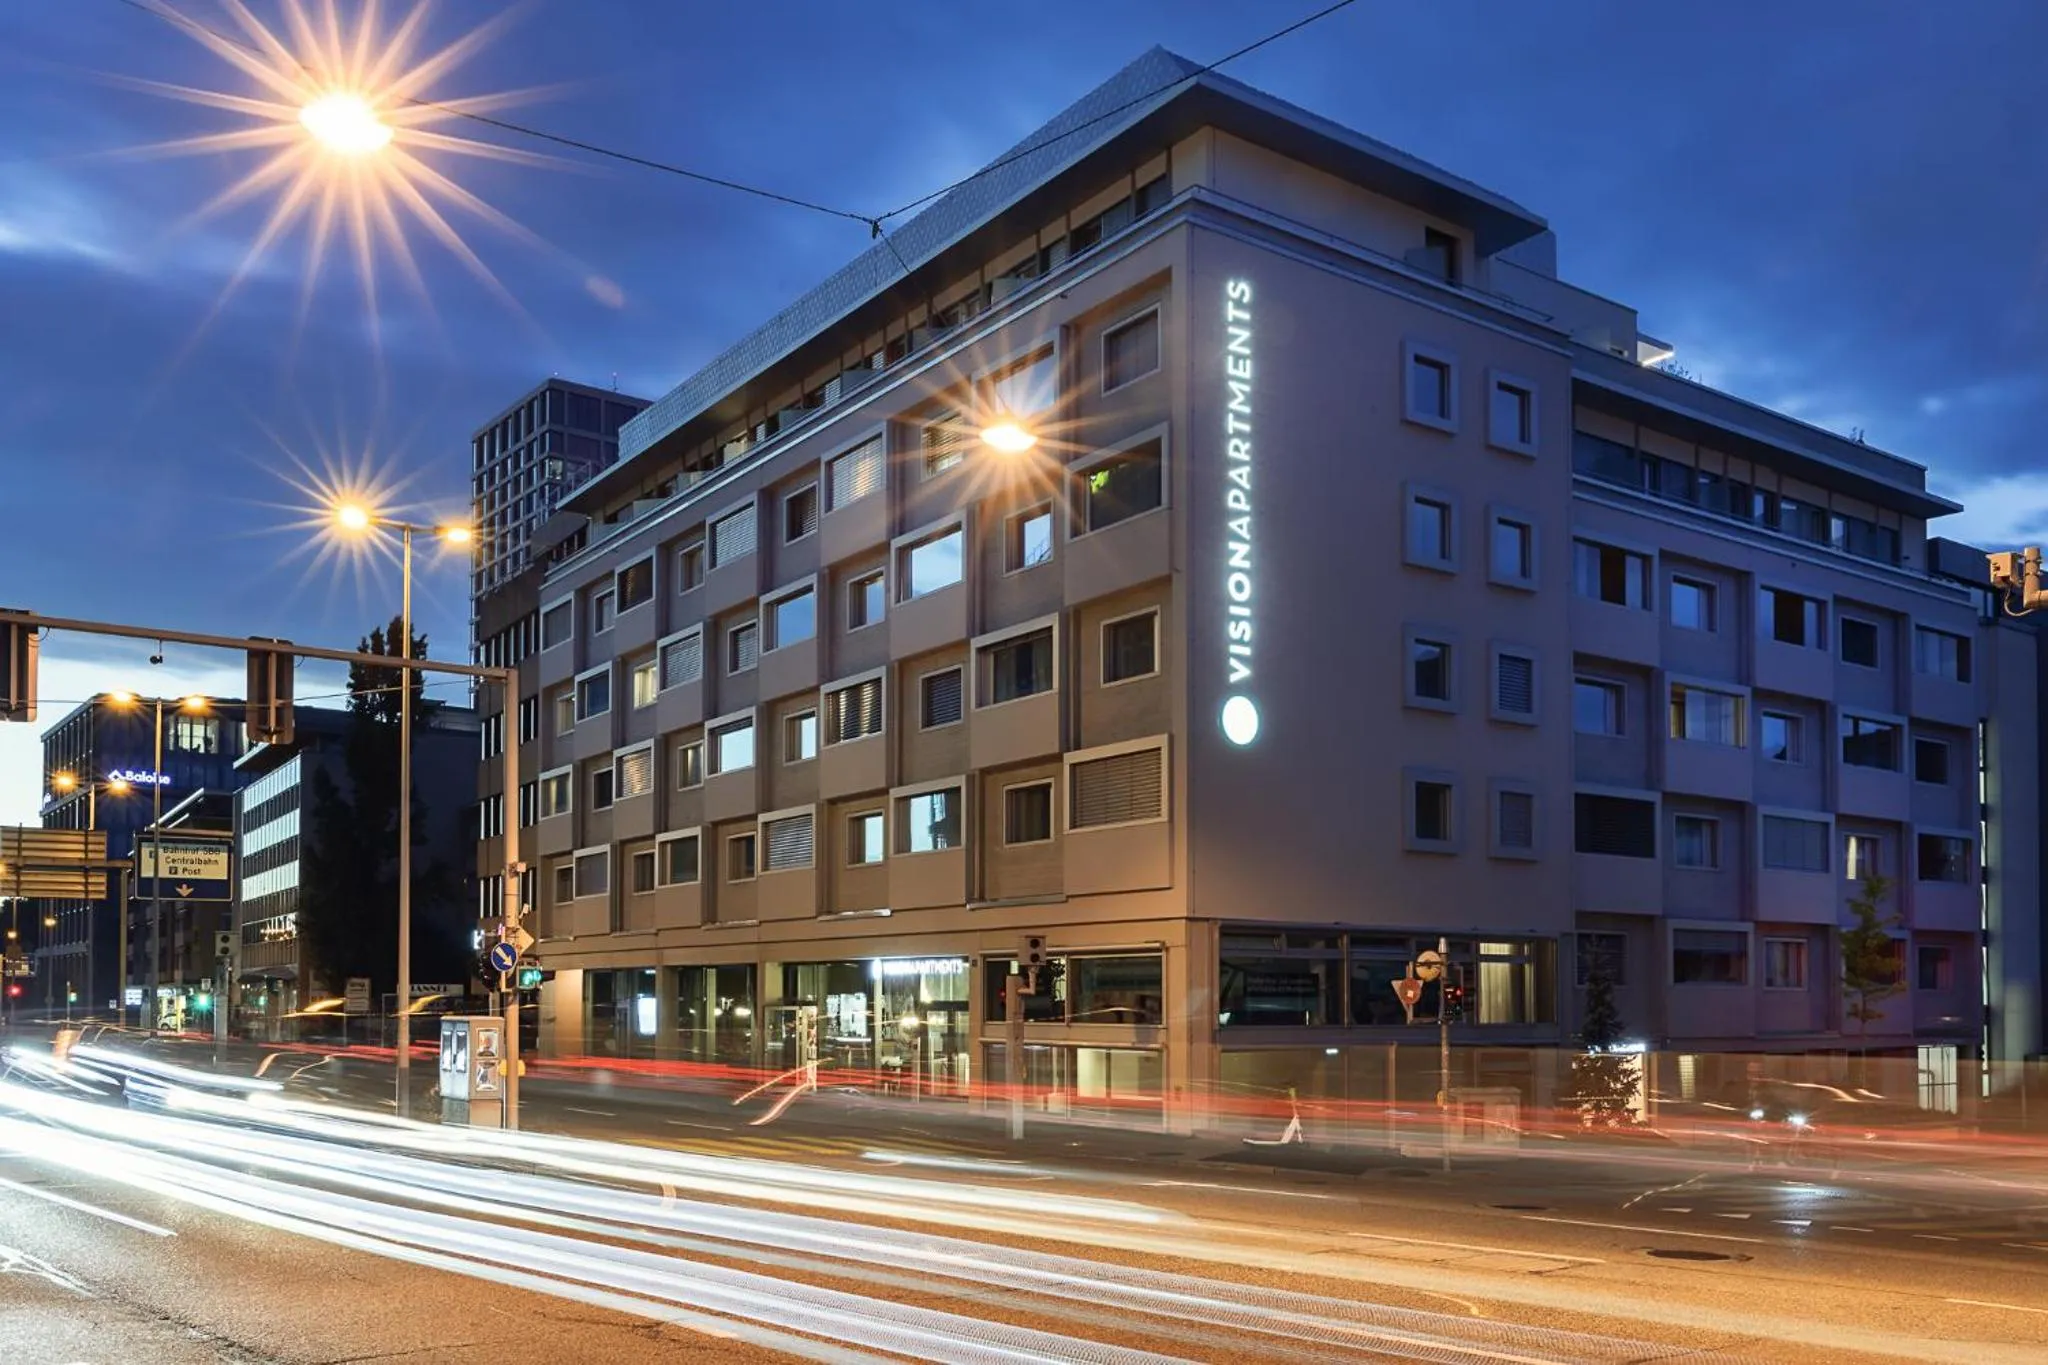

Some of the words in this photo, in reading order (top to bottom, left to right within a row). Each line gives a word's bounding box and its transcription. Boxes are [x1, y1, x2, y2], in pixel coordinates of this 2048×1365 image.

[1227, 279, 1252, 683] VISIONAPARTMENTS
[163, 846, 199, 854] Bahnhof
[165, 856, 219, 865] Centralbahn
[182, 867, 201, 875] Post
